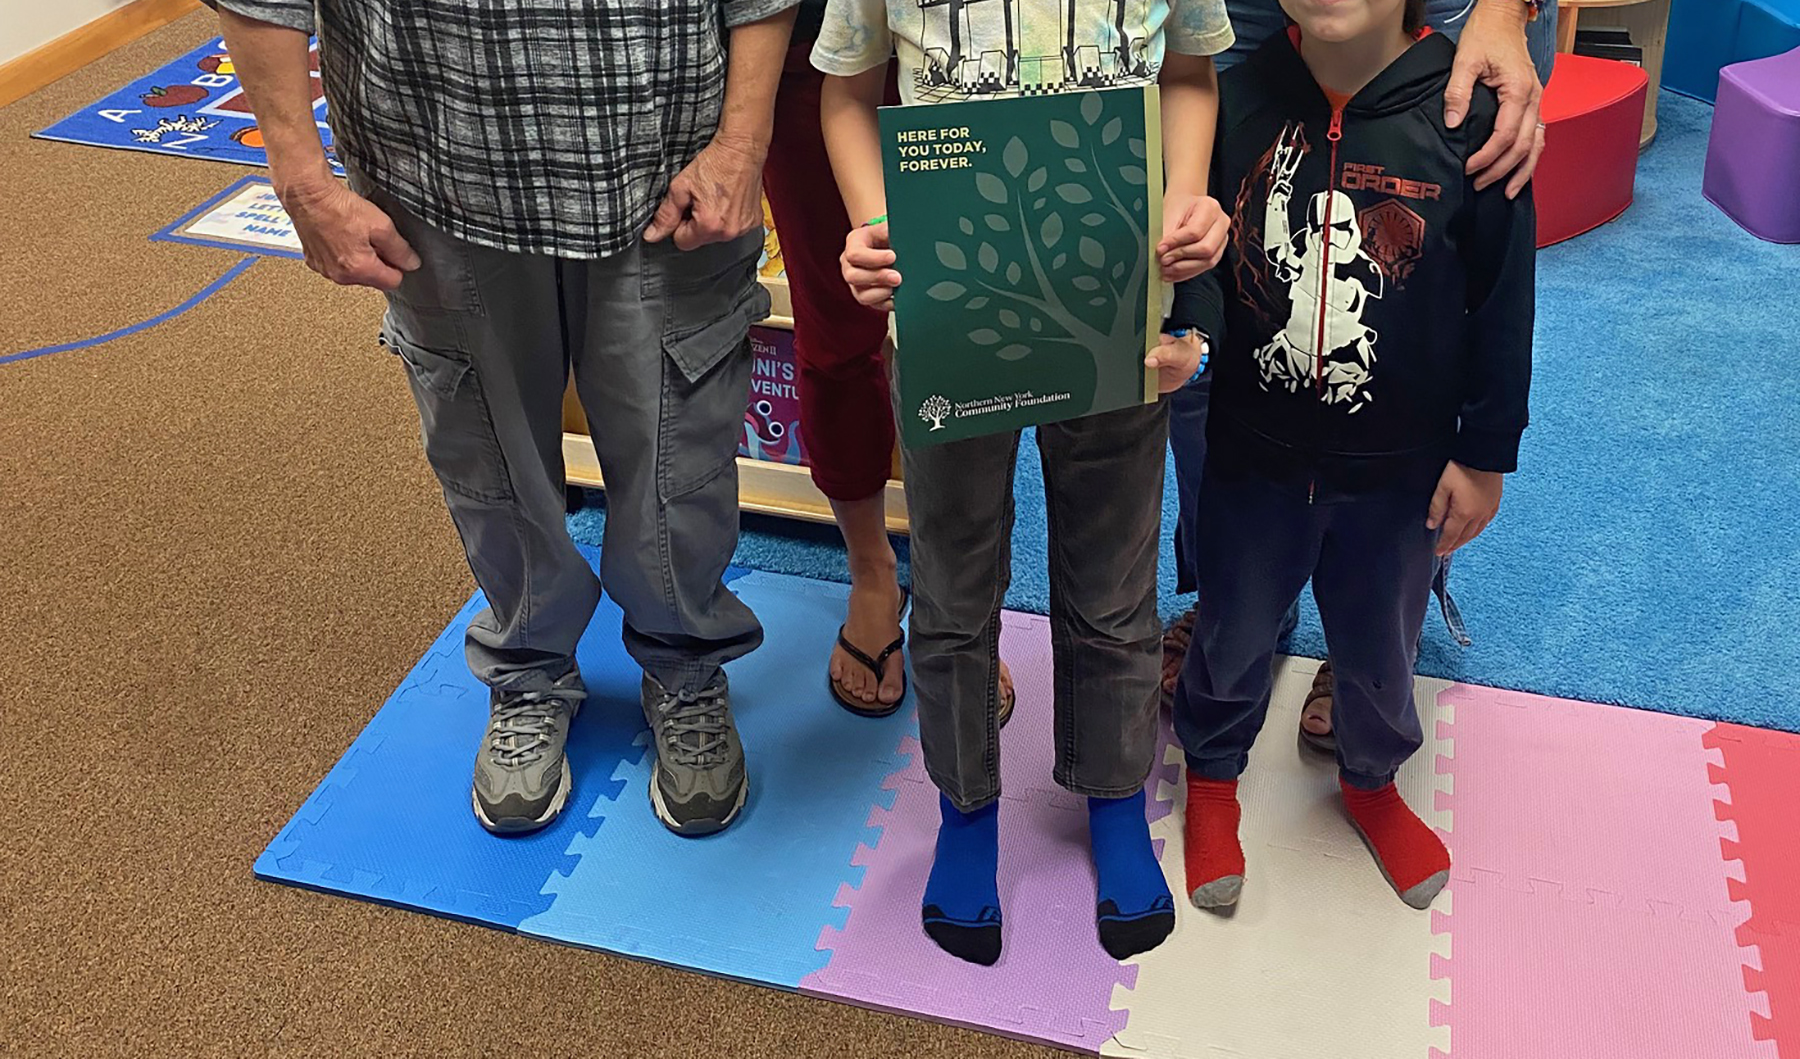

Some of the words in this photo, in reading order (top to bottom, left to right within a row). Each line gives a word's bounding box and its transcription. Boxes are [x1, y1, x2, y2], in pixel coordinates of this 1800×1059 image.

[897, 129, 937, 143] HERE
[940, 127, 970, 140] FOR
[898, 144, 929, 157] YOU
[933, 140, 987, 155] TODAY,
[900, 156, 973, 172] FOREVER.
[1343, 162, 1386, 174] FIRST
[1340, 171, 1442, 200] ORDER
[235, 211, 280, 223] SPELL
[243, 224, 292, 237] NAME
[954, 397, 993, 410] Northern
[994, 395, 1013, 405] New
[1014, 391, 1033, 401] York
[954, 400, 1014, 418] Community
[1015, 392, 1071, 408] Foundation
